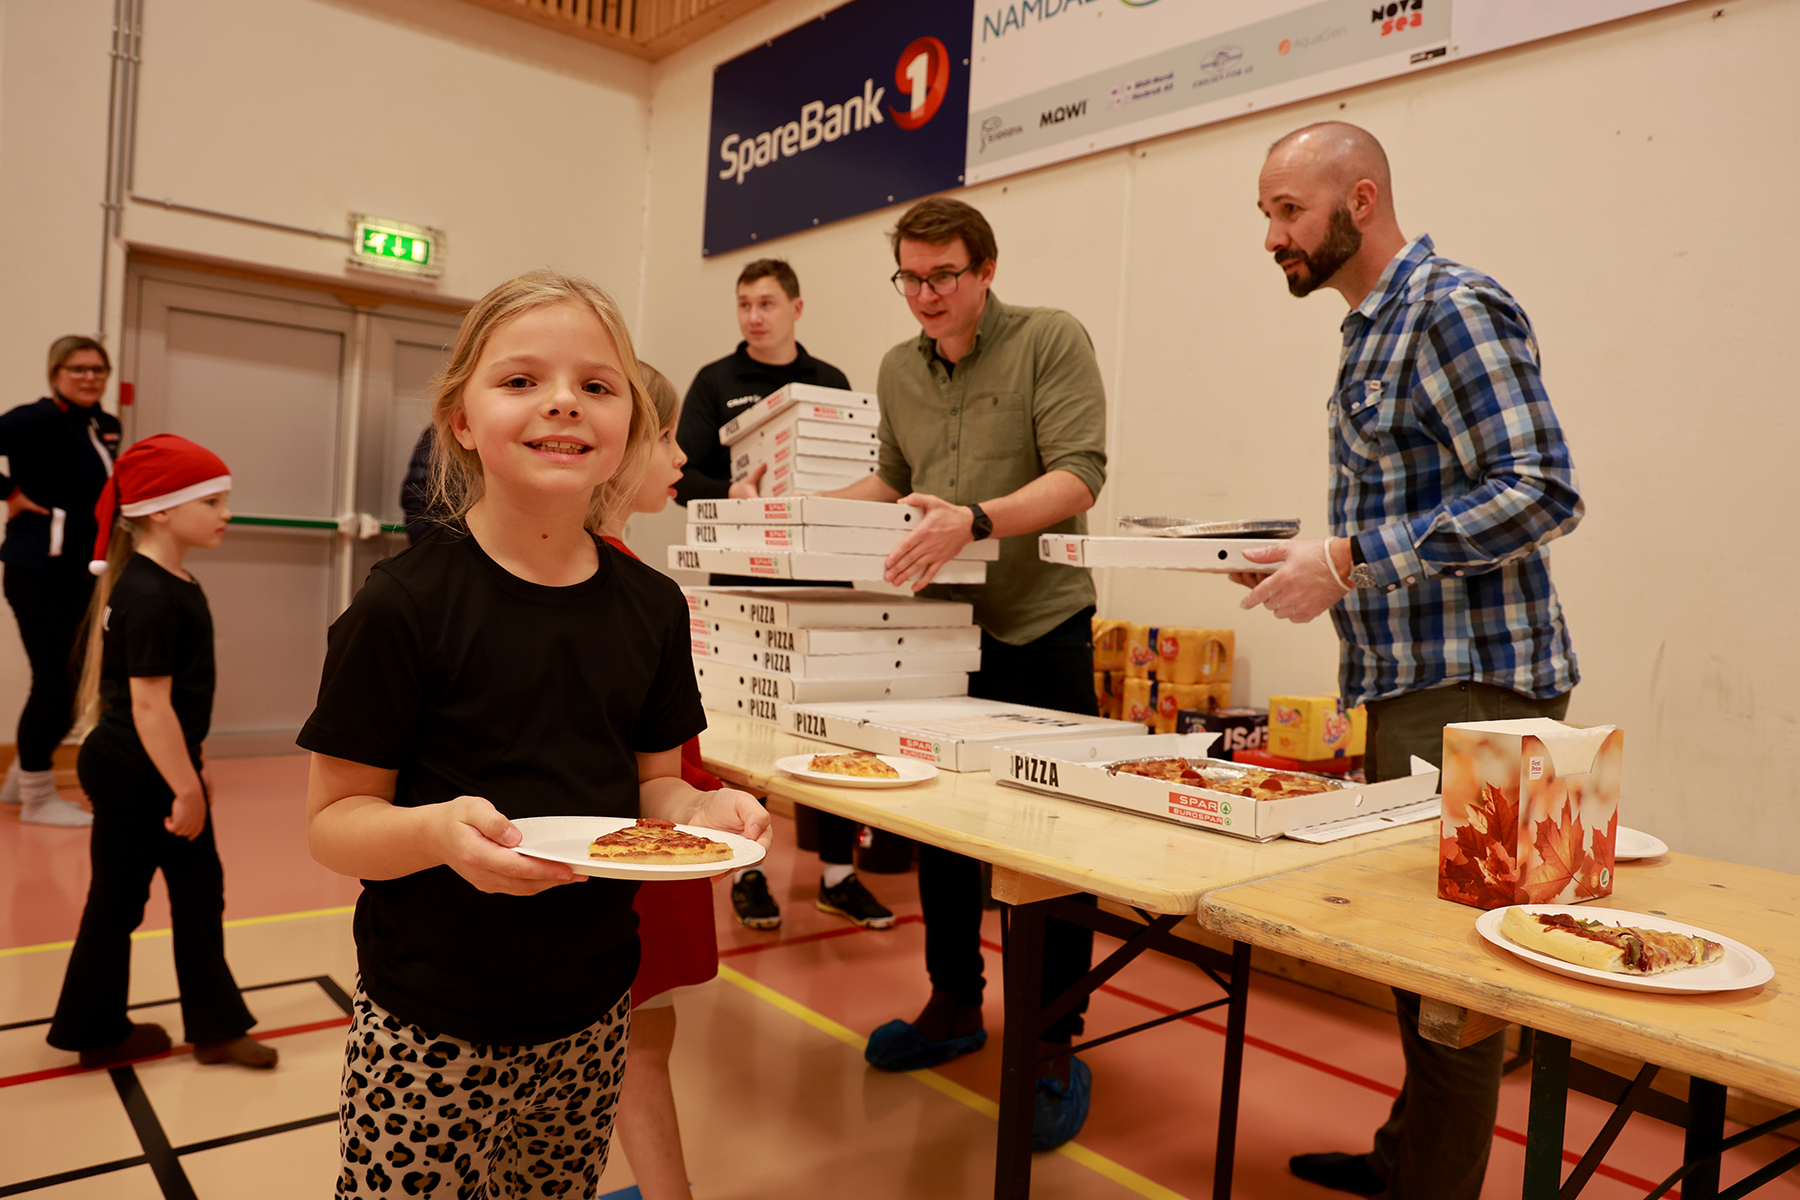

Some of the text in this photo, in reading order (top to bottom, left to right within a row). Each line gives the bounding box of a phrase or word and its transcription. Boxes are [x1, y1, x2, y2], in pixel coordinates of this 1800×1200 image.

[982, 0, 1100, 42] NAMD
[1381, 12, 1422, 36] sea
[719, 52, 929, 185] SpareBank 1
[1039, 100, 1087, 128] MOWI
[697, 502, 718, 519] PIZZA
[696, 526, 717, 543] PIZZA
[678, 551, 700, 568] PIZZA
[751, 604, 775, 625] PIZZA
[767, 630, 794, 651] PIZZA
[765, 652, 791, 673] PIZZA
[752, 677, 779, 699] PIZZA
[750, 699, 777, 721] PIZZA
[796, 712, 827, 738] PIZZA
[906, 739, 931, 750] SPAR
[1224, 725, 1268, 751] PSI
[1015, 755, 1059, 787] PIZZA
[1179, 795, 1217, 811] SPAR
[1173, 808, 1222, 824] EUROSPAR
